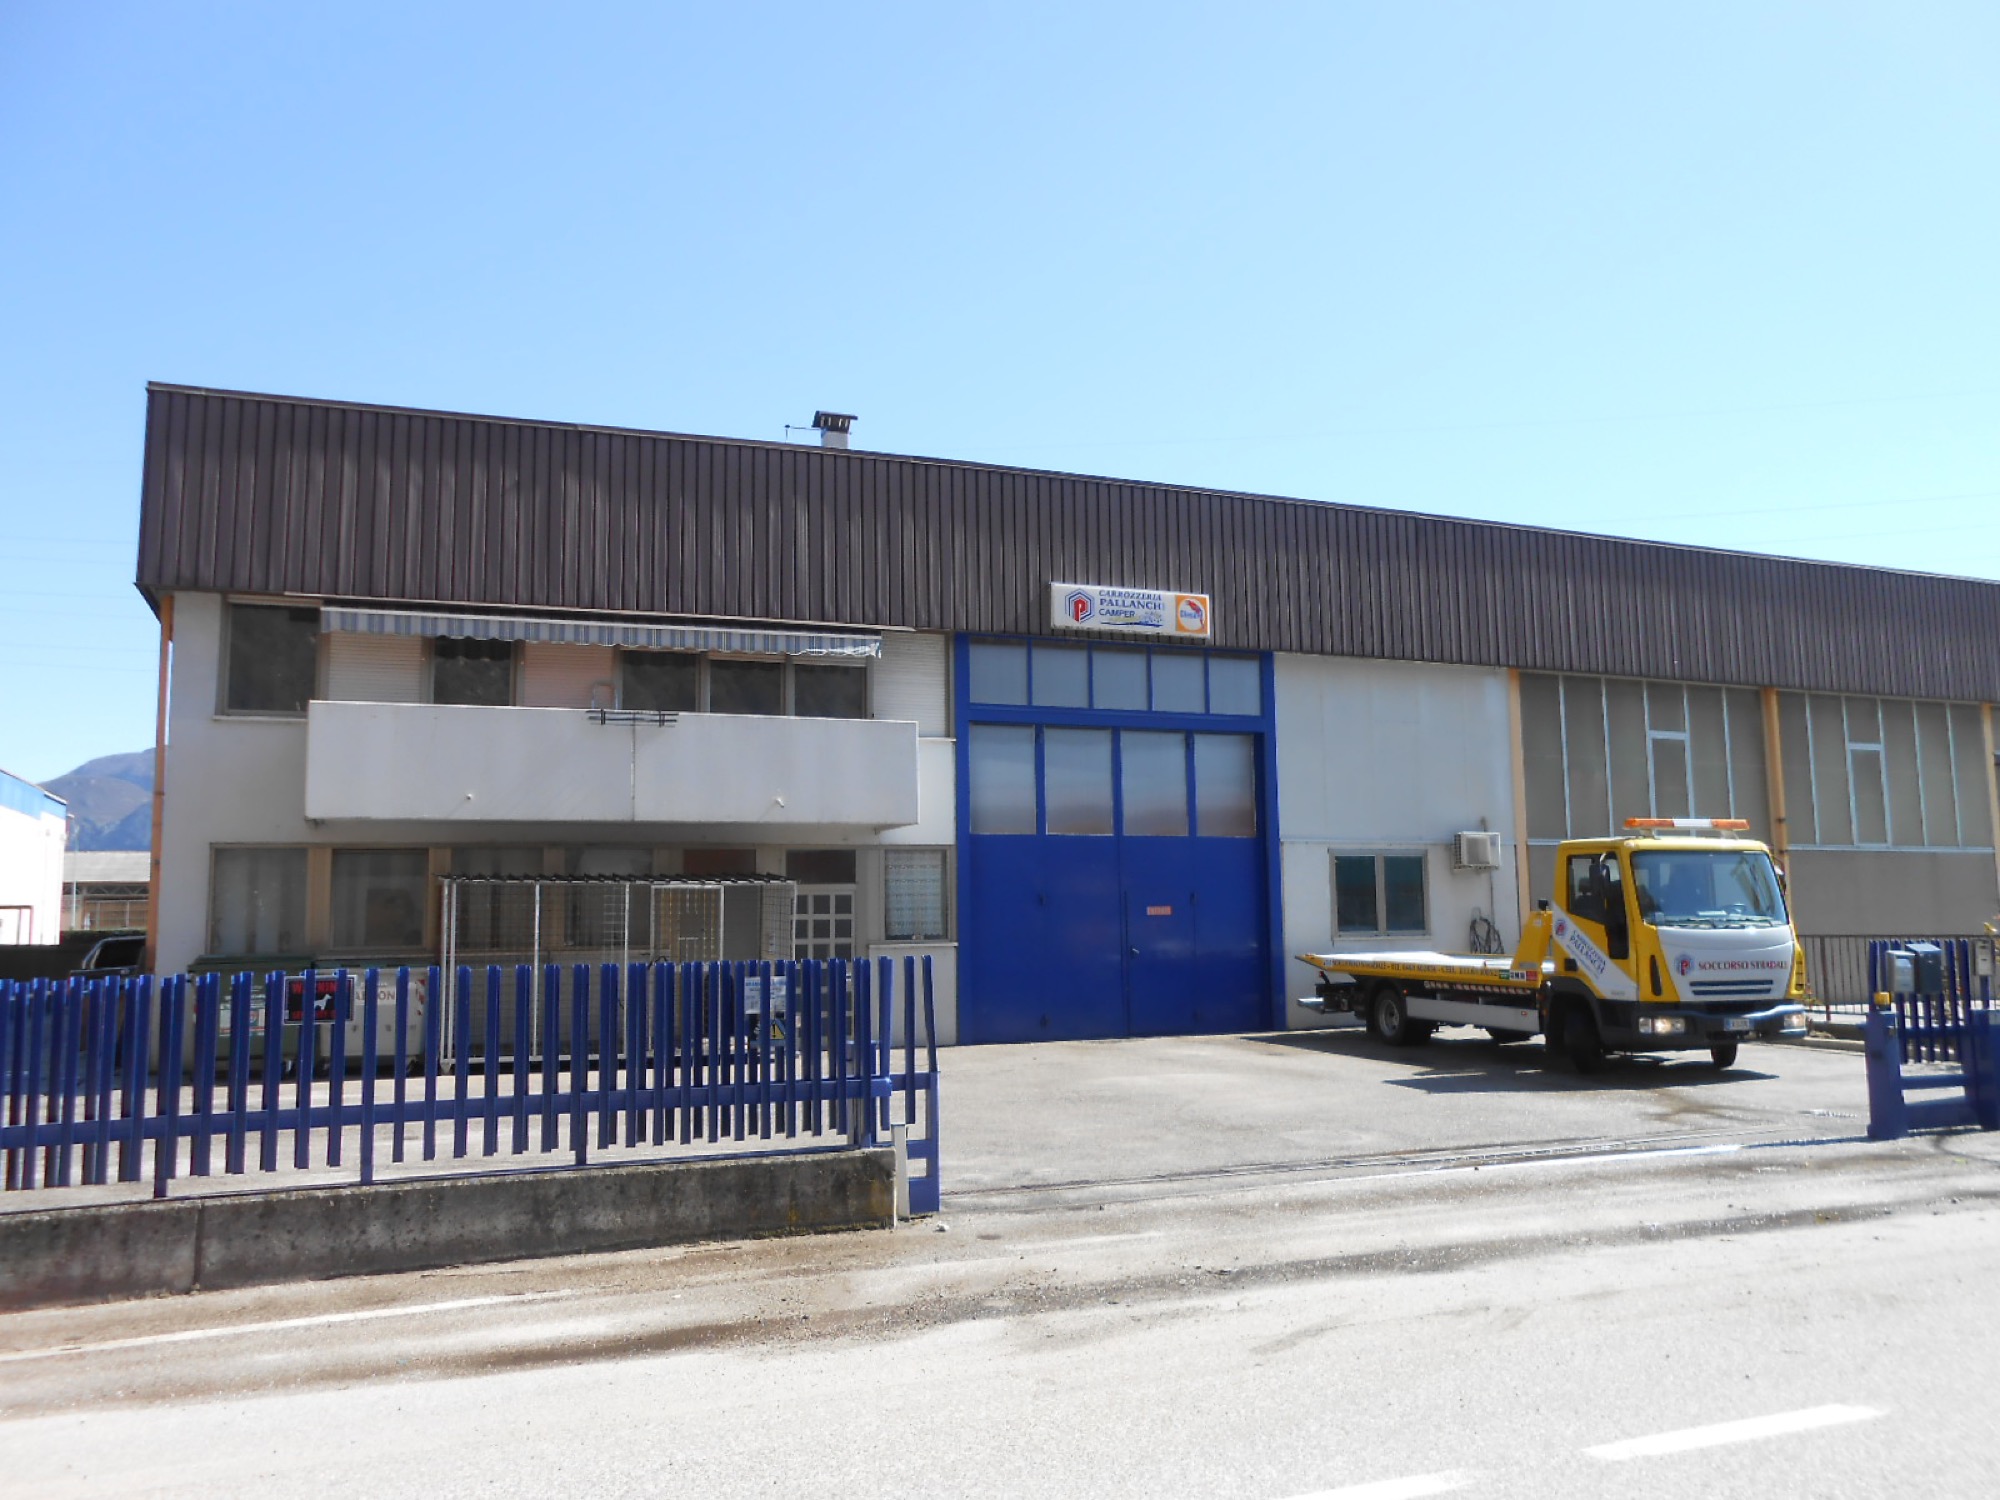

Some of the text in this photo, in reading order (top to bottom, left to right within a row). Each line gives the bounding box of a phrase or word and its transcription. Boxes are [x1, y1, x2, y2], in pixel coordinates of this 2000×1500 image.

[1099, 589, 1162, 601] CARROZZERIA
[1099, 608, 1136, 618] CAMPER
[1698, 960, 1749, 971] SOCCORSO
